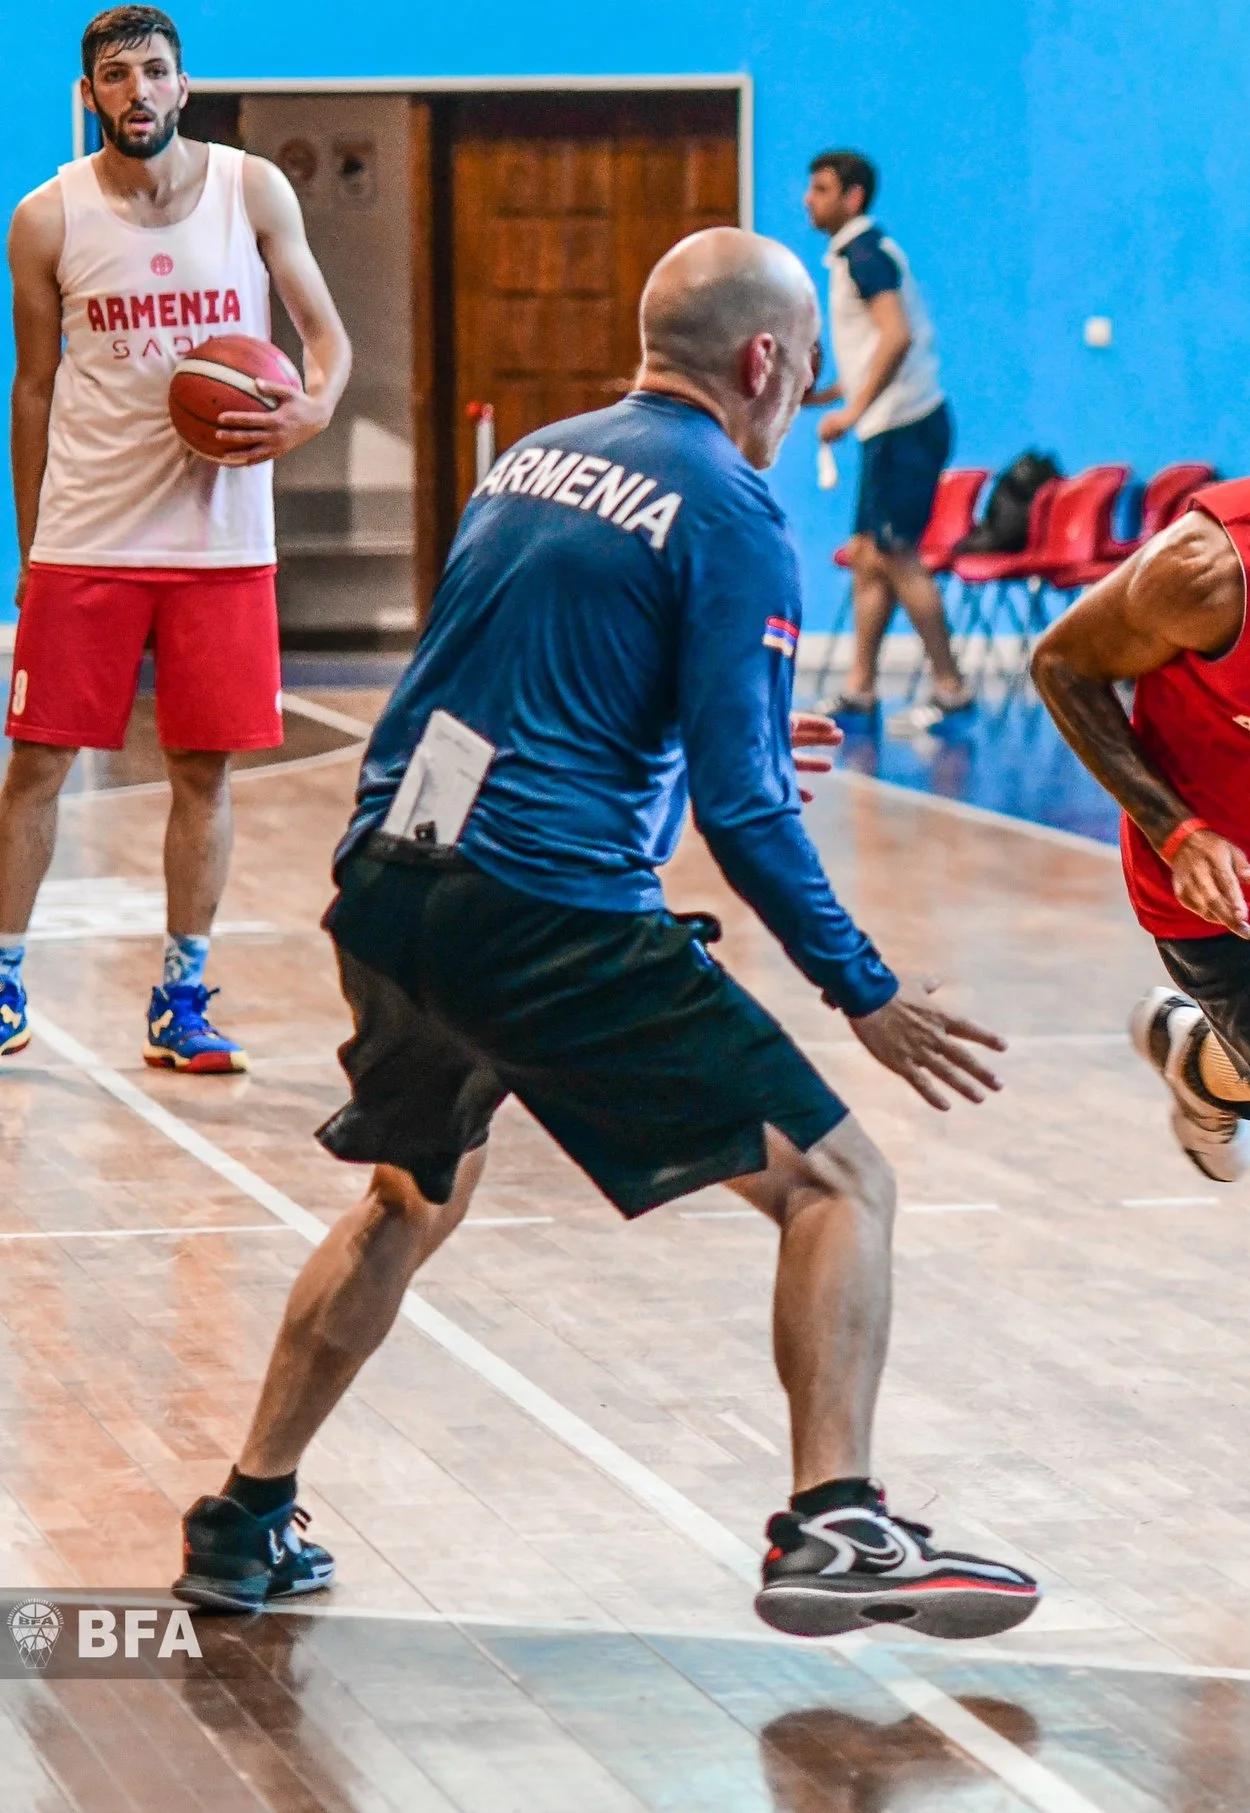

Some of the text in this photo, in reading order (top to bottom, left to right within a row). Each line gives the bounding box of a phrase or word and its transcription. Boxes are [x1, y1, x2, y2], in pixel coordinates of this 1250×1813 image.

[87, 289, 241, 332] ARMENIA
[112, 335, 213, 360] SAD
[472, 448, 683, 550] ARMENIA
